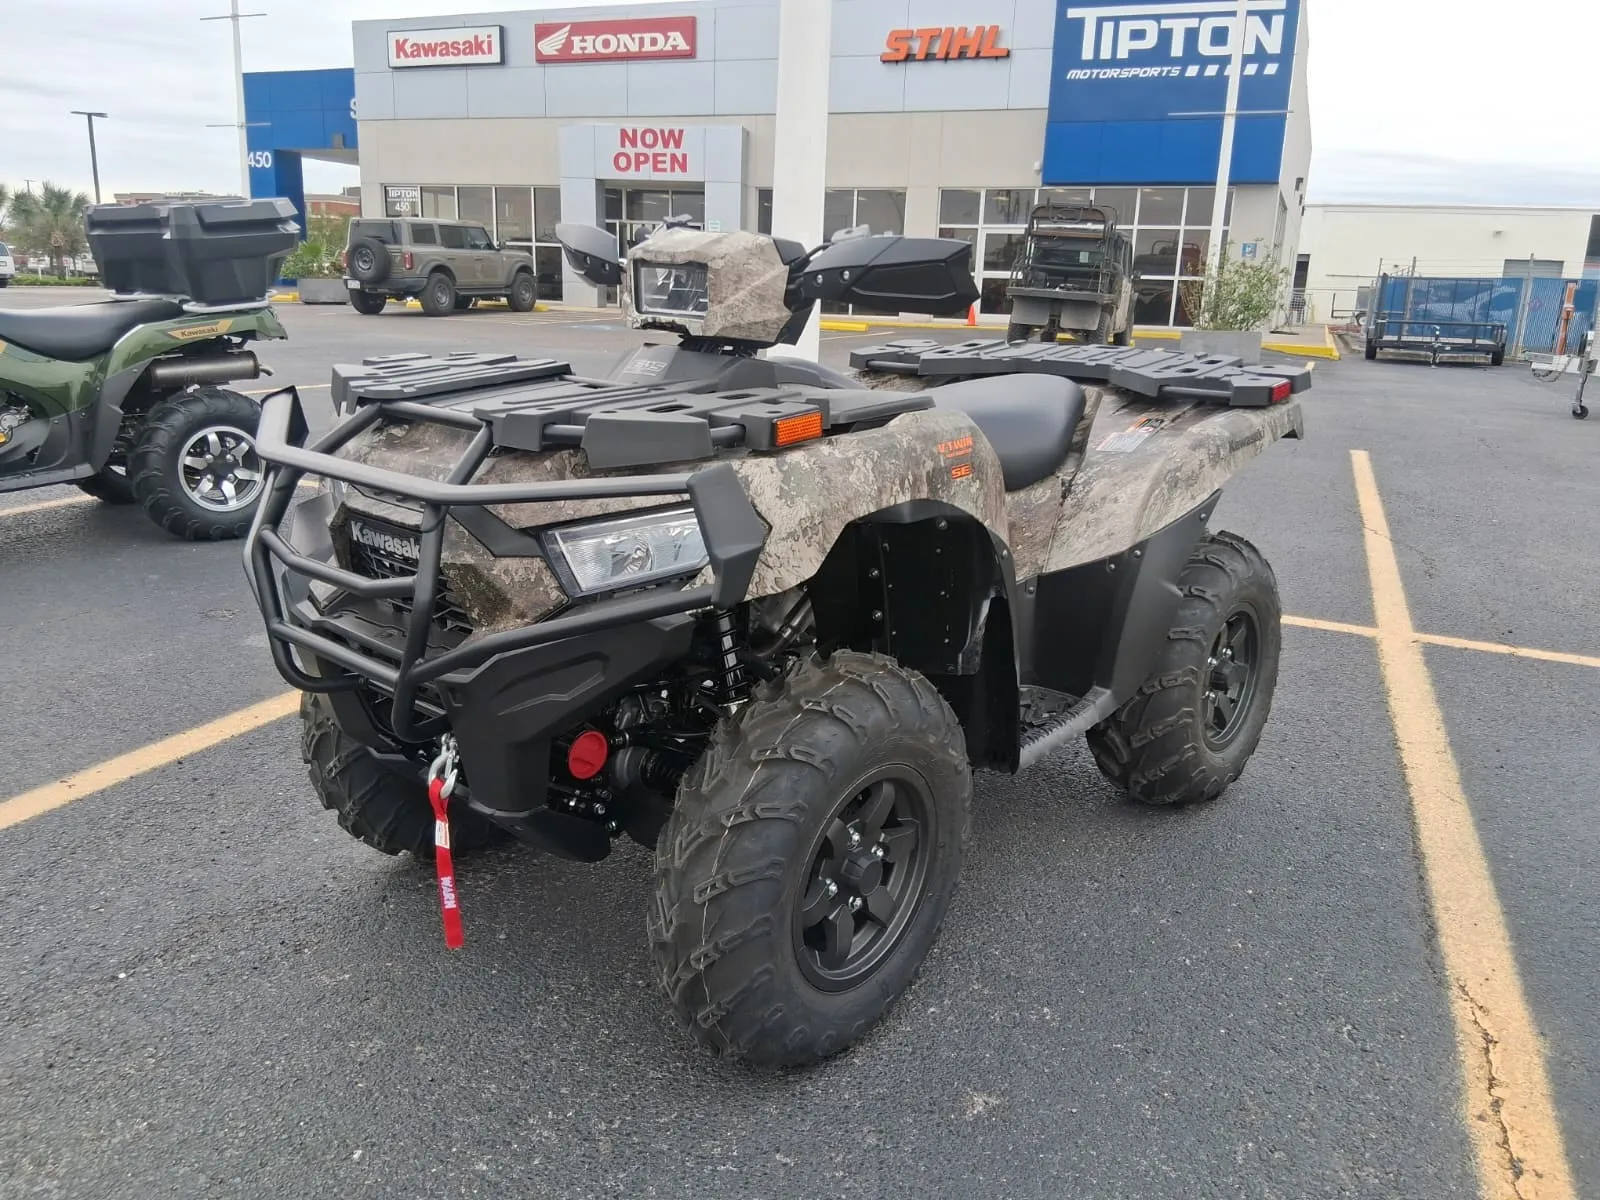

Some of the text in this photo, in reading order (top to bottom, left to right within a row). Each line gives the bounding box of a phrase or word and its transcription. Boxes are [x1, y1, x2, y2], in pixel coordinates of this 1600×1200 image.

[1067, 0, 1287, 60] TIPTON
[394, 34, 493, 59] Kawasaki
[571, 31, 690, 54] HONDA
[880, 25, 1010, 62] STIHL
[1066, 66, 1181, 80] MOTORSPORTS
[619, 128, 684, 149] NOW
[248, 151, 272, 168] 450
[613, 151, 688, 173] OPEN
[387, 187, 418, 198] TIPTON
[394, 201, 410, 212] 450
[180, 326, 218, 337] Kawasaki
[951, 463, 971, 479] SE
[351, 520, 421, 561] Kawasak
[440, 876, 457, 909] WARN
